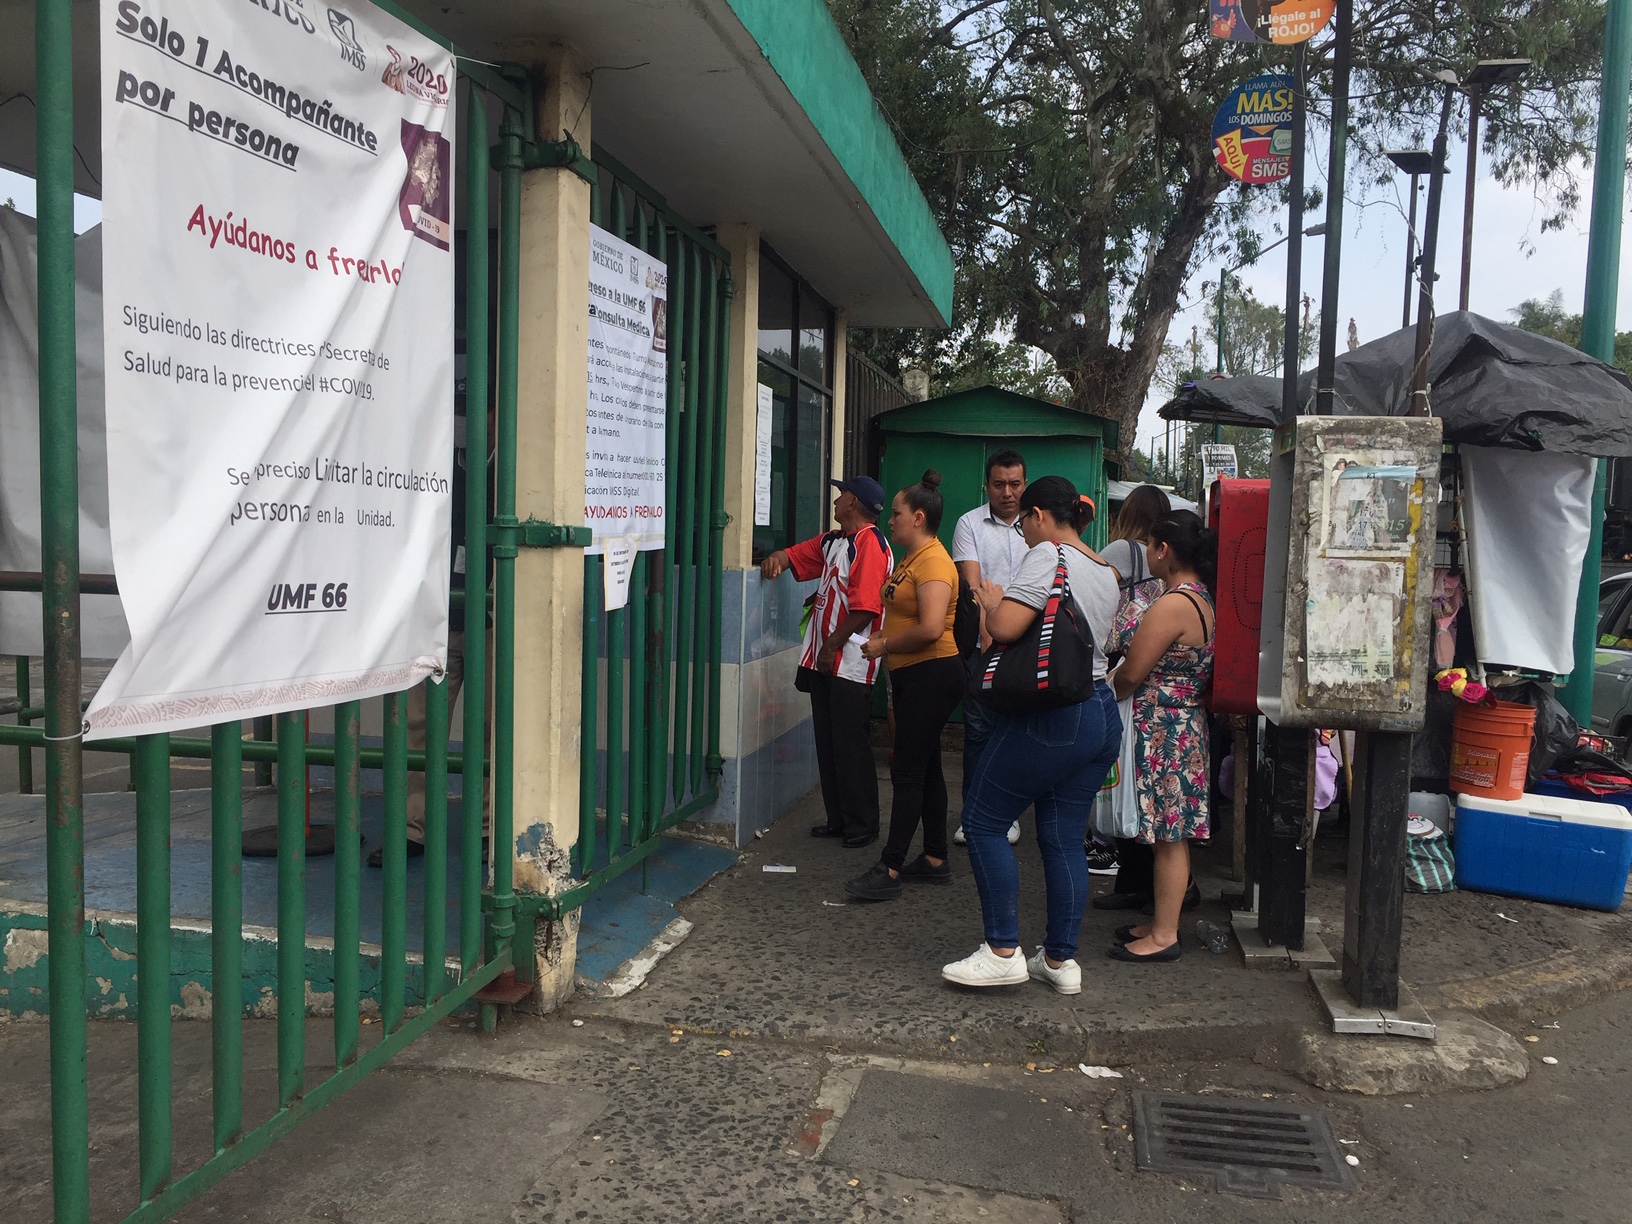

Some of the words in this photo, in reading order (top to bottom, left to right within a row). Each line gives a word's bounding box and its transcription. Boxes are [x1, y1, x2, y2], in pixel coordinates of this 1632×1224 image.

[1310, 8, 1321, 19] al
[1268, 22, 1315, 39] ROJO!
[115, 0, 185, 56] Solo
[196, 37, 209, 66] 1
[213, 50, 378, 152] Acompañante
[407, 56, 448, 95] 2020
[1245, 82, 1268, 91] LLAMA
[1236, 88, 1294, 114] MÁS!
[115, 69, 177, 113] por
[188, 101, 299, 167] persona
[1240, 111, 1293, 125] DOMINGOS
[1251, 162, 1289, 178] SMS
[187, 204, 296, 263] Ayúdanos
[306, 250, 318, 271] a
[593, 239, 617, 259] GOBIERNO
[592, 251, 624, 275] MÉXICO
[608, 290, 613, 300] a
[614, 288, 622, 304] la
[623, 292, 638, 309] UMF
[638, 299, 647, 314] 66
[597, 309, 626, 329] onsulta
[122, 305, 201, 341] Siguiendo
[206, 321, 227, 346] las
[231, 329, 316, 358] directrices
[377, 352, 389, 370] de
[123, 350, 171, 378] Salud
[176, 361, 209, 385] para
[214, 365, 228, 387] la
[601, 393, 613, 404] Los
[616, 412, 623, 422] de
[227, 467, 250, 486] Se
[361, 461, 373, 487] la
[376, 466, 450, 494] circulación
[317, 509, 331, 524] en
[334, 506, 344, 524] la
[357, 509, 395, 528] Unidad.
[267, 583, 317, 611] UMF
[320, 582, 348, 610] 66
